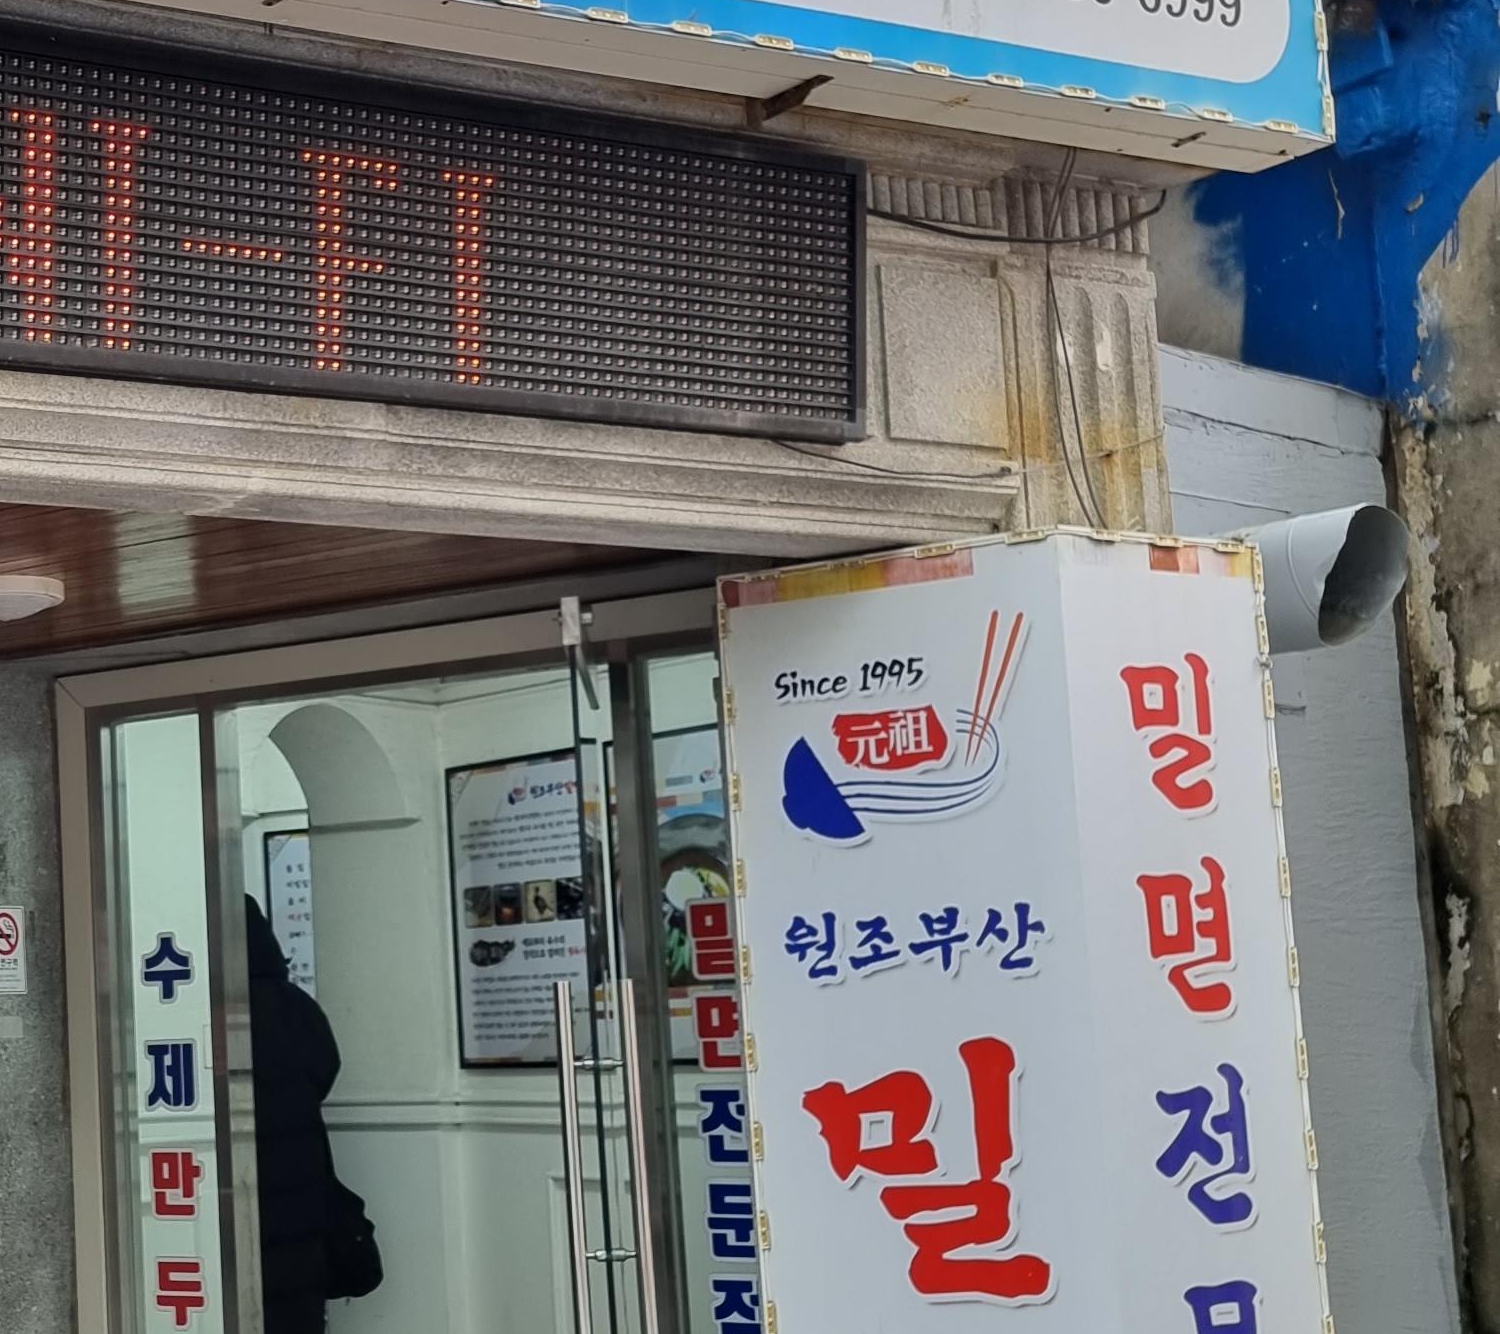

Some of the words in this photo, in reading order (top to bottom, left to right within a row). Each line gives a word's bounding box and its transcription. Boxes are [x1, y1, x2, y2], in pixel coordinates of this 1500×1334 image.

[775, 668, 848, 701] Since
[859, 657, 924, 689] 1995
[845, 710, 933, 766] 元祖
[784, 903, 1045, 978] 원조부산
